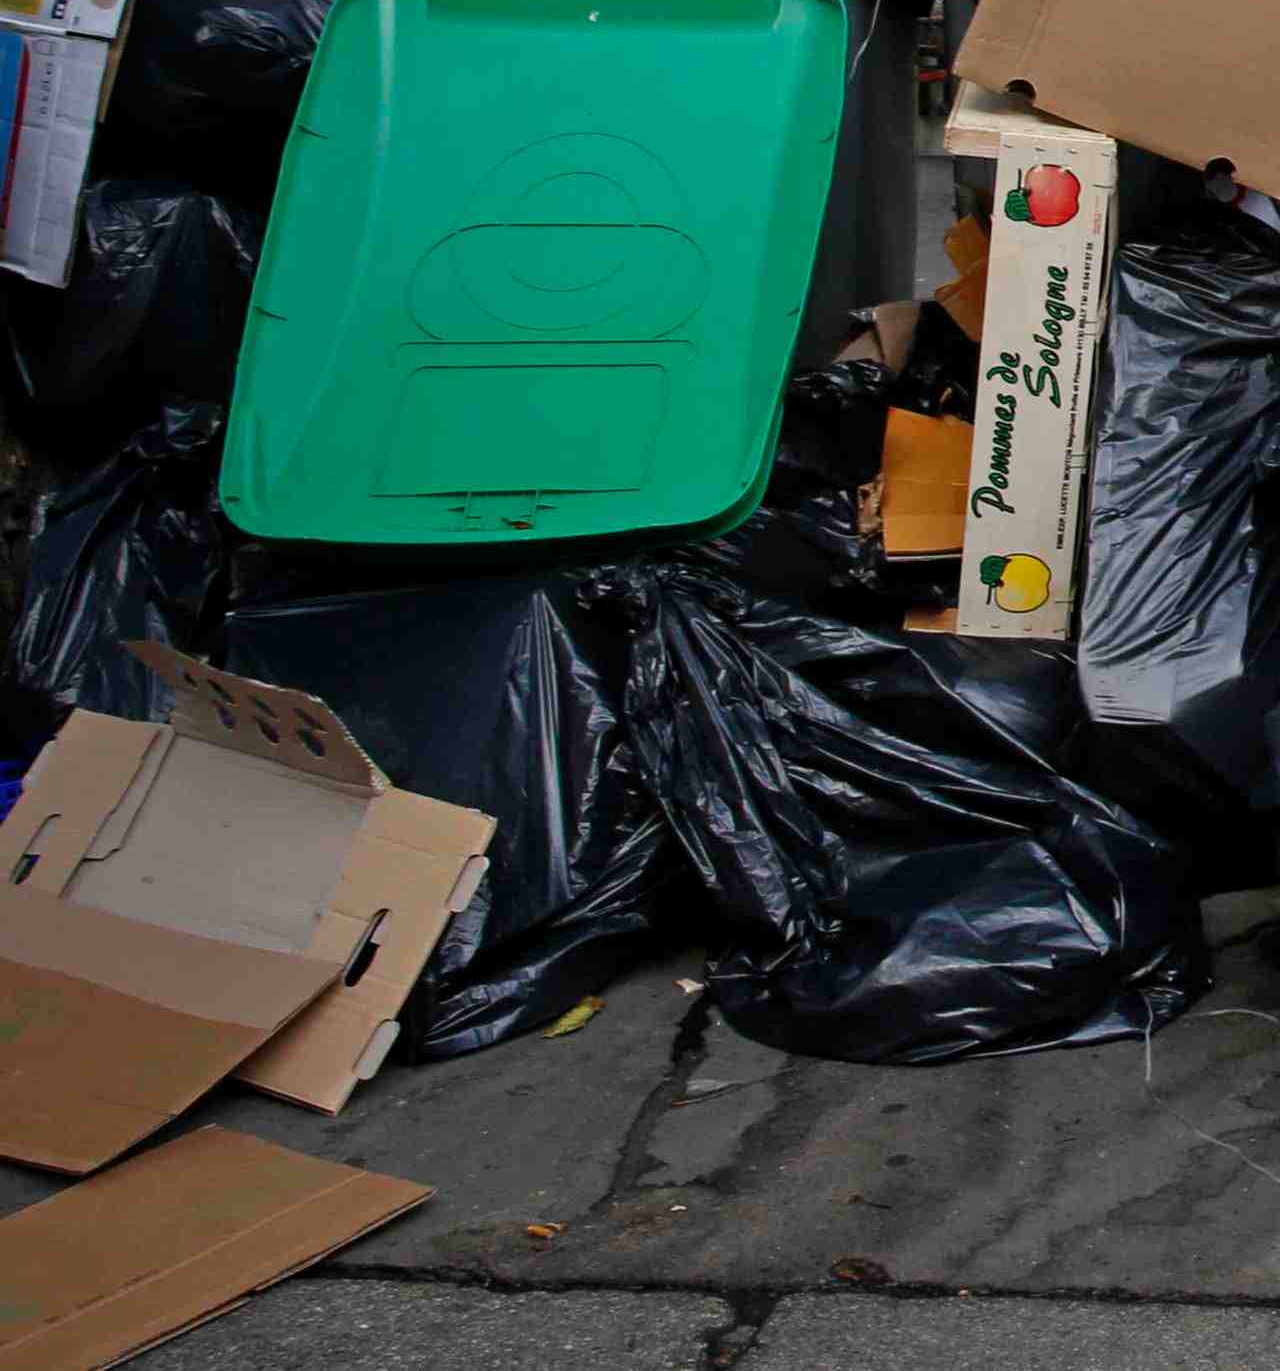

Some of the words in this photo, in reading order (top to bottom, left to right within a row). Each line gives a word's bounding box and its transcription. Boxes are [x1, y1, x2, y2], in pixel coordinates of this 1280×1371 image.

[986, 351, 1021, 385] de
[1023, 265, 1075, 408] Sologne
[972, 388, 1016, 518] Pommes
